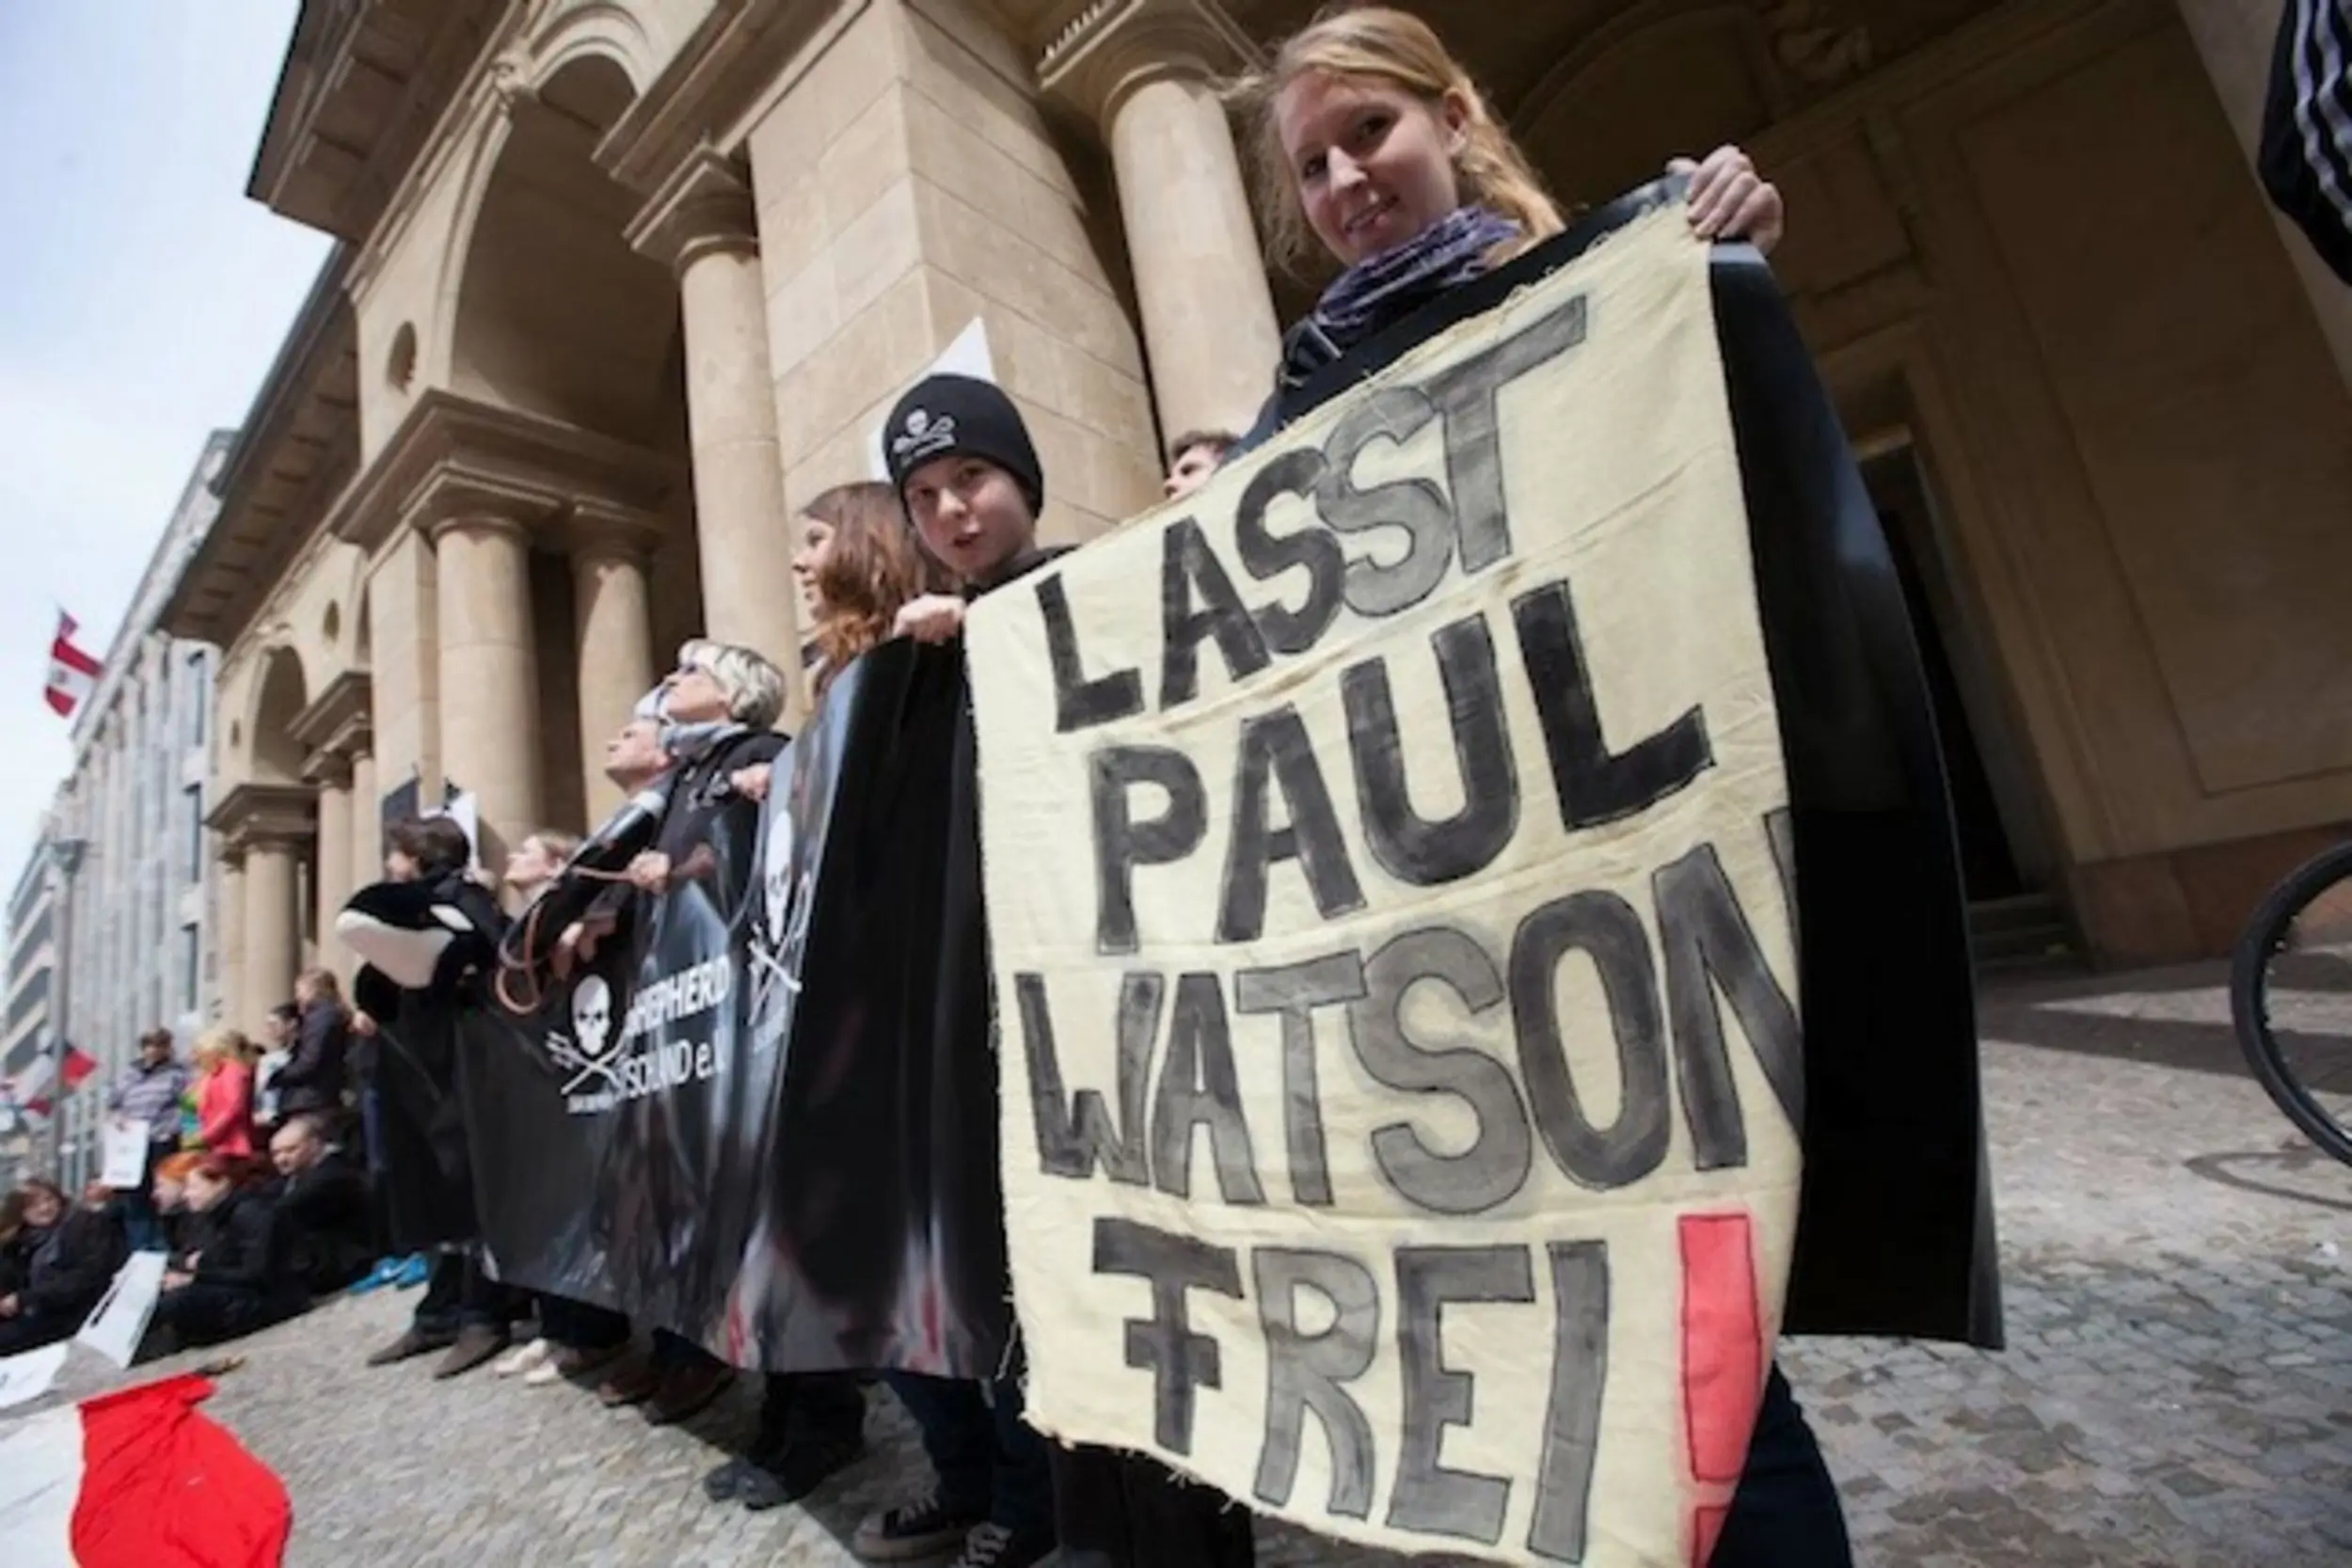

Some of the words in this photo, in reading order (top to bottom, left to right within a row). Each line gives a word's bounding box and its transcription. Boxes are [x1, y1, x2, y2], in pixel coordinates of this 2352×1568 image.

[1036, 293, 1587, 734] LASST
[1088, 578, 1717, 956] PAUL
[1014, 806, 1804, 1215] WATSON
